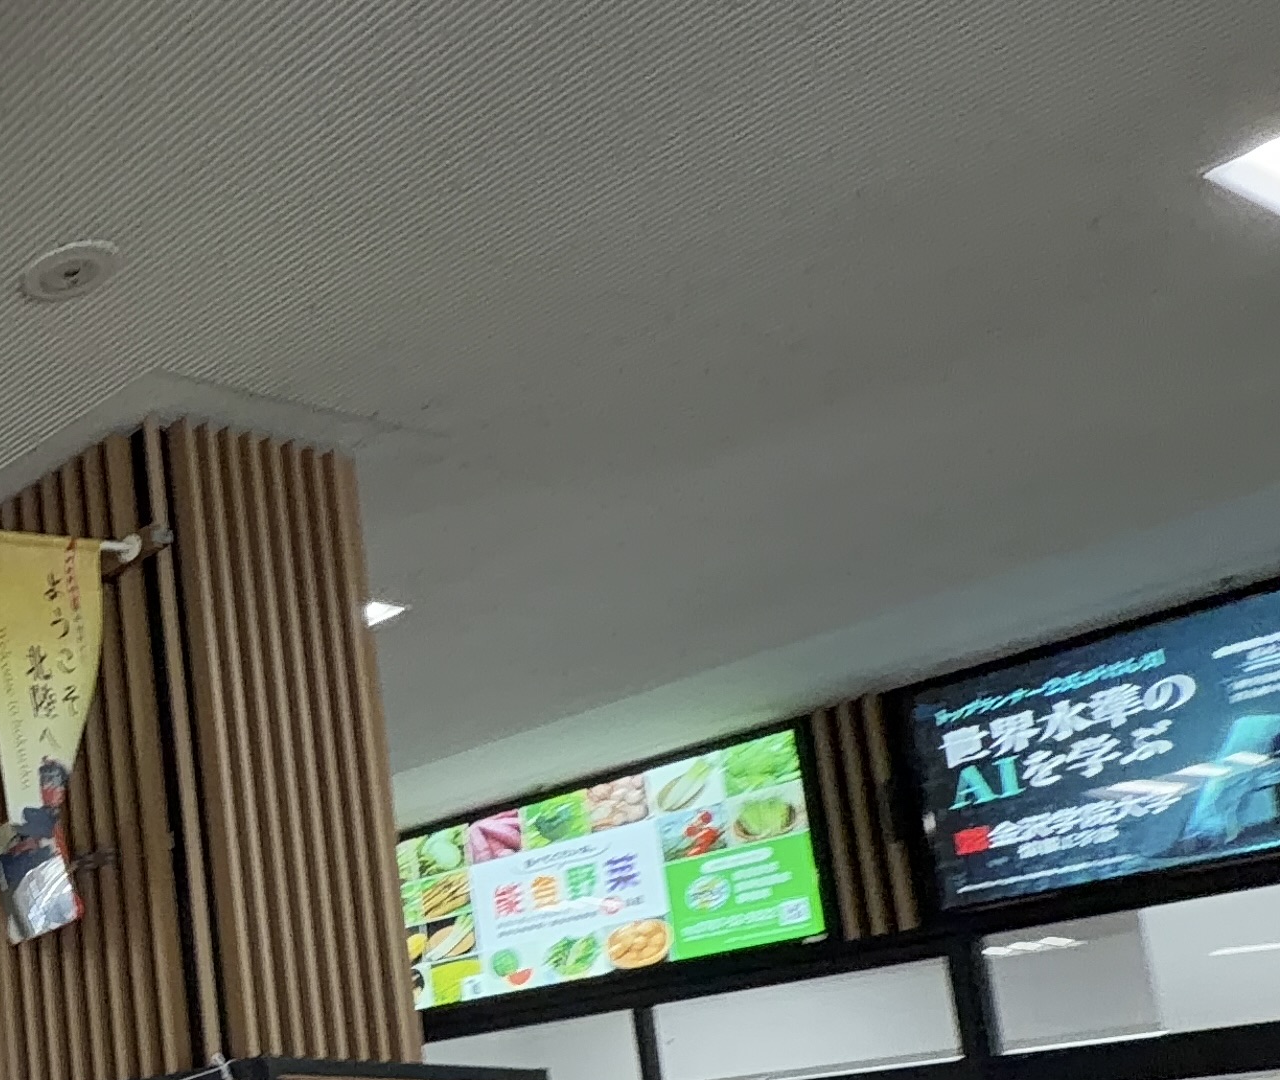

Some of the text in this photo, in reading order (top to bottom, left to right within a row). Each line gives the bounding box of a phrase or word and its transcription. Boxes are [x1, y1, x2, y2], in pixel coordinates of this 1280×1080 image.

[44, 573, 80, 717] ようこそ
[25, 645, 61, 749] 北陸へ
[938, 674, 1196, 769] 世界水準の
[948, 719, 1174, 811] AIを学ぶ
